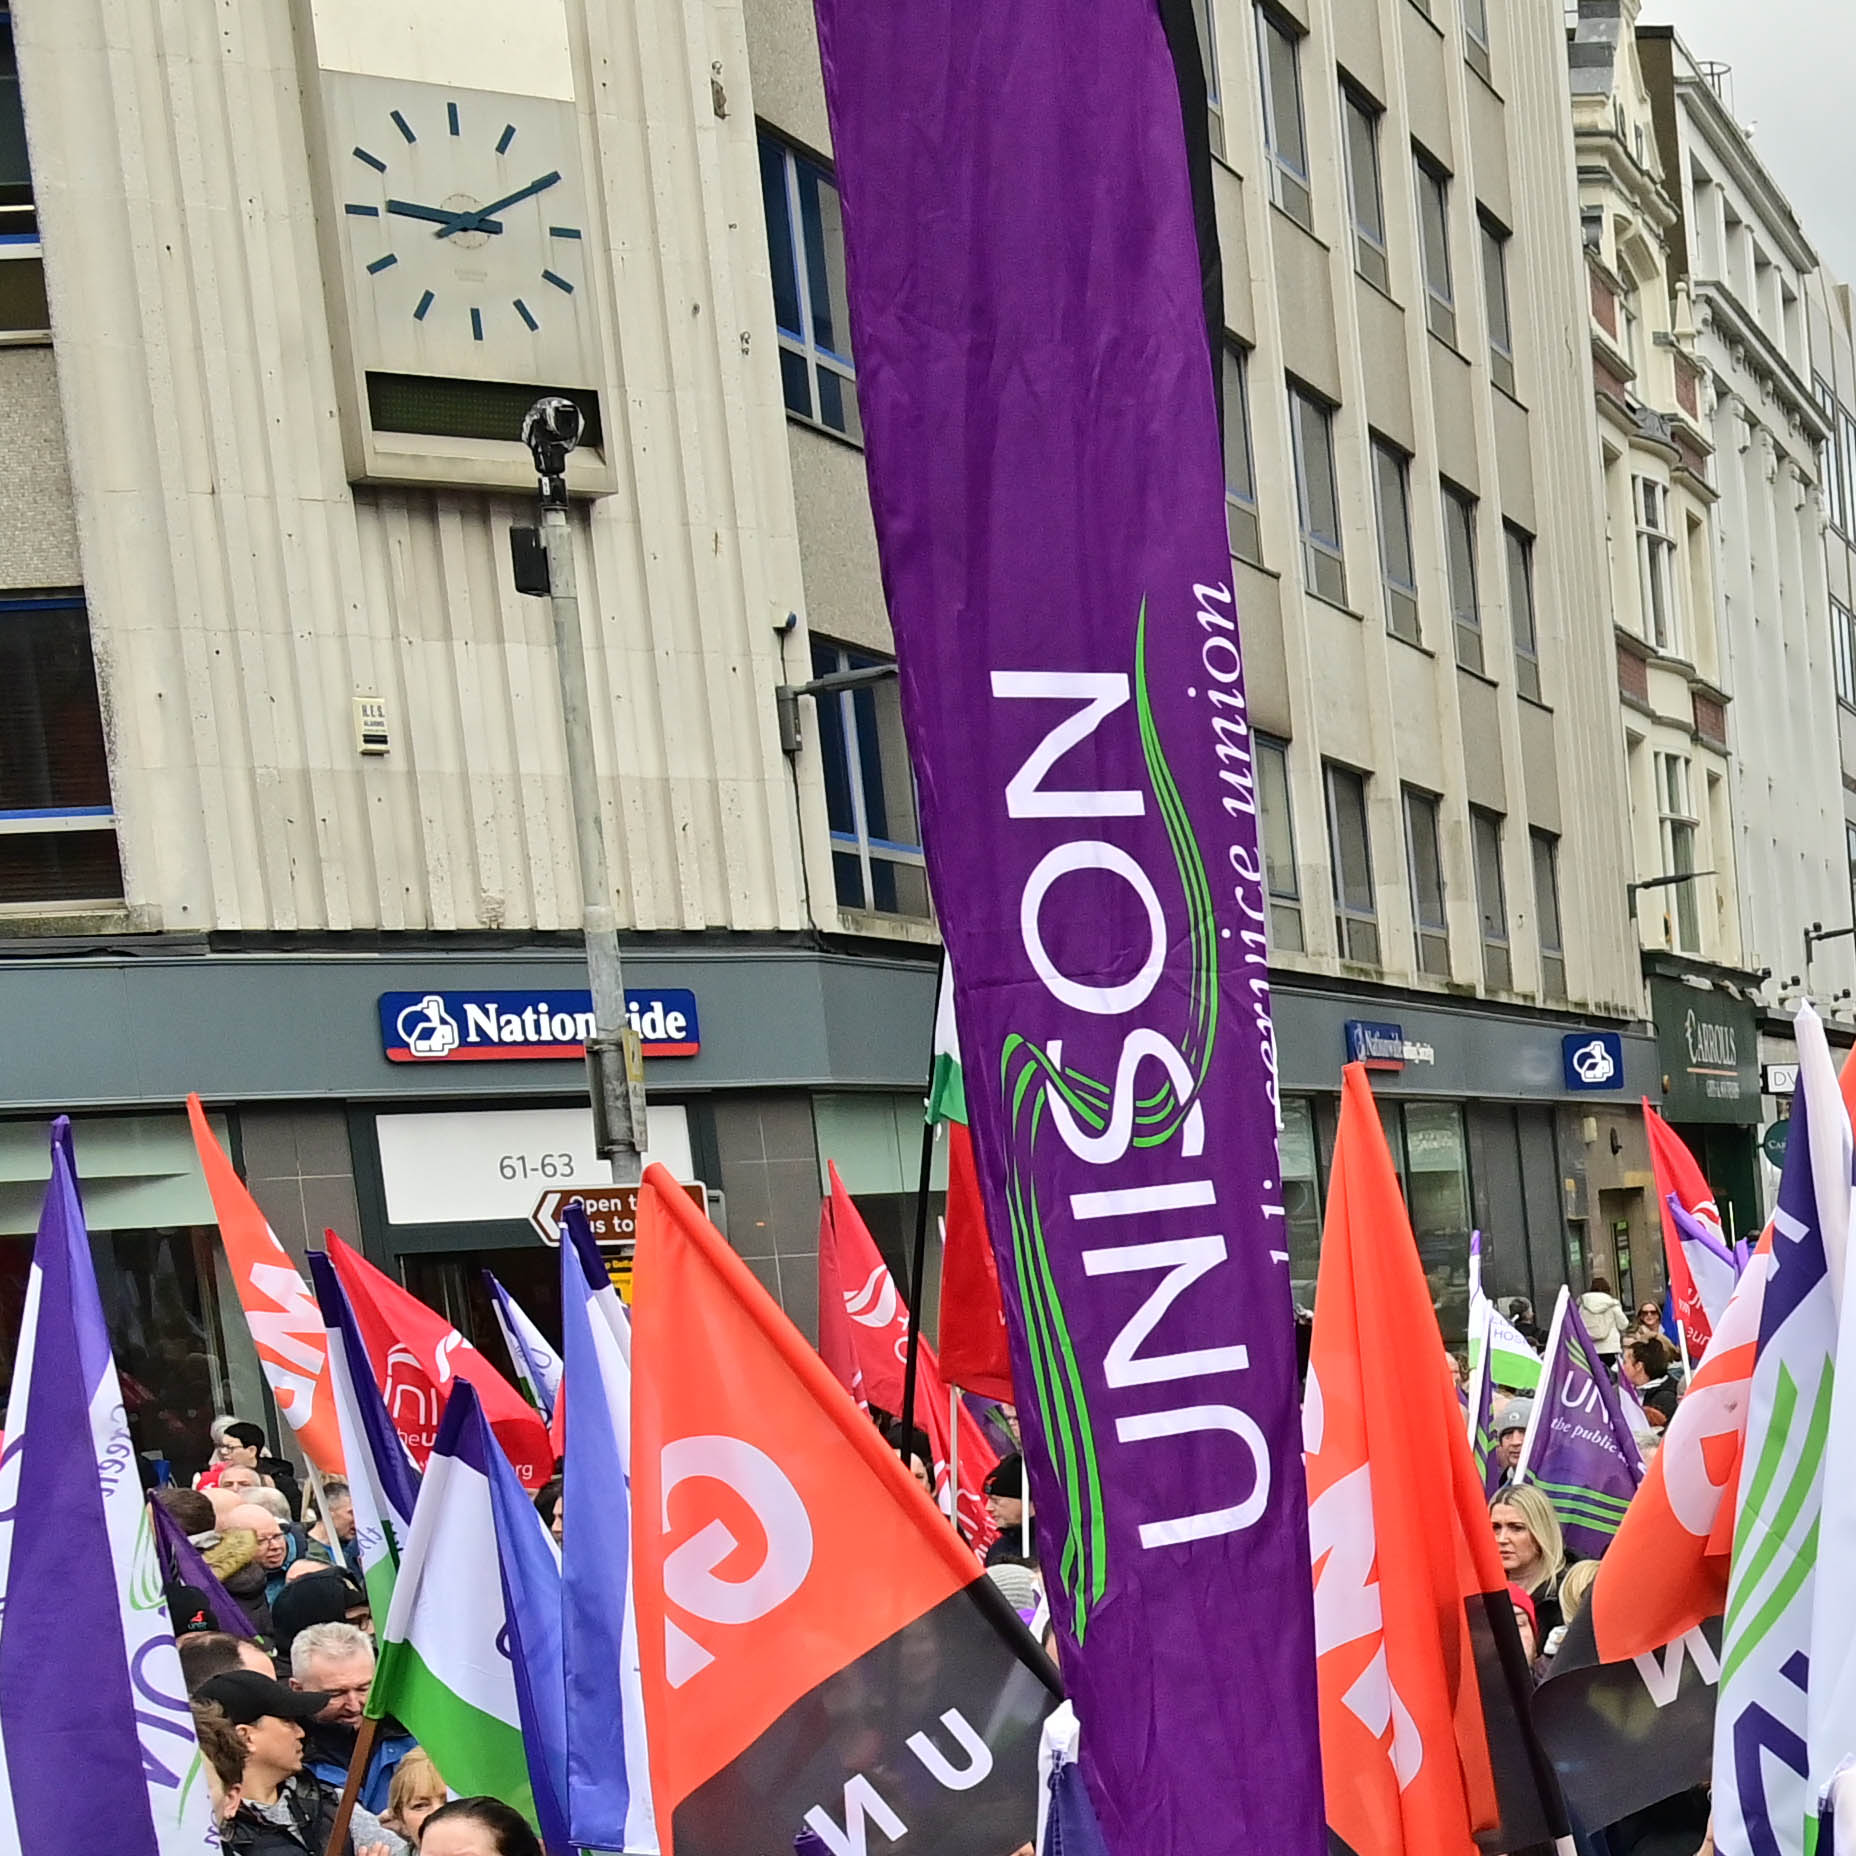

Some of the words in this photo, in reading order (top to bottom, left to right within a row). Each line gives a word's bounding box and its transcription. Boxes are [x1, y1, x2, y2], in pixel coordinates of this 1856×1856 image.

[1192, 580, 1259, 820] union
[463, 1003, 686, 1043] Nationide
[990, 668, 1271, 1551] UNISON
[499, 1153, 576, 1181] 61-63
[613, 1214, 637, 1233] to
[1550, 1417, 1571, 1439] the
[1573, 1424, 1618, 1453] public
